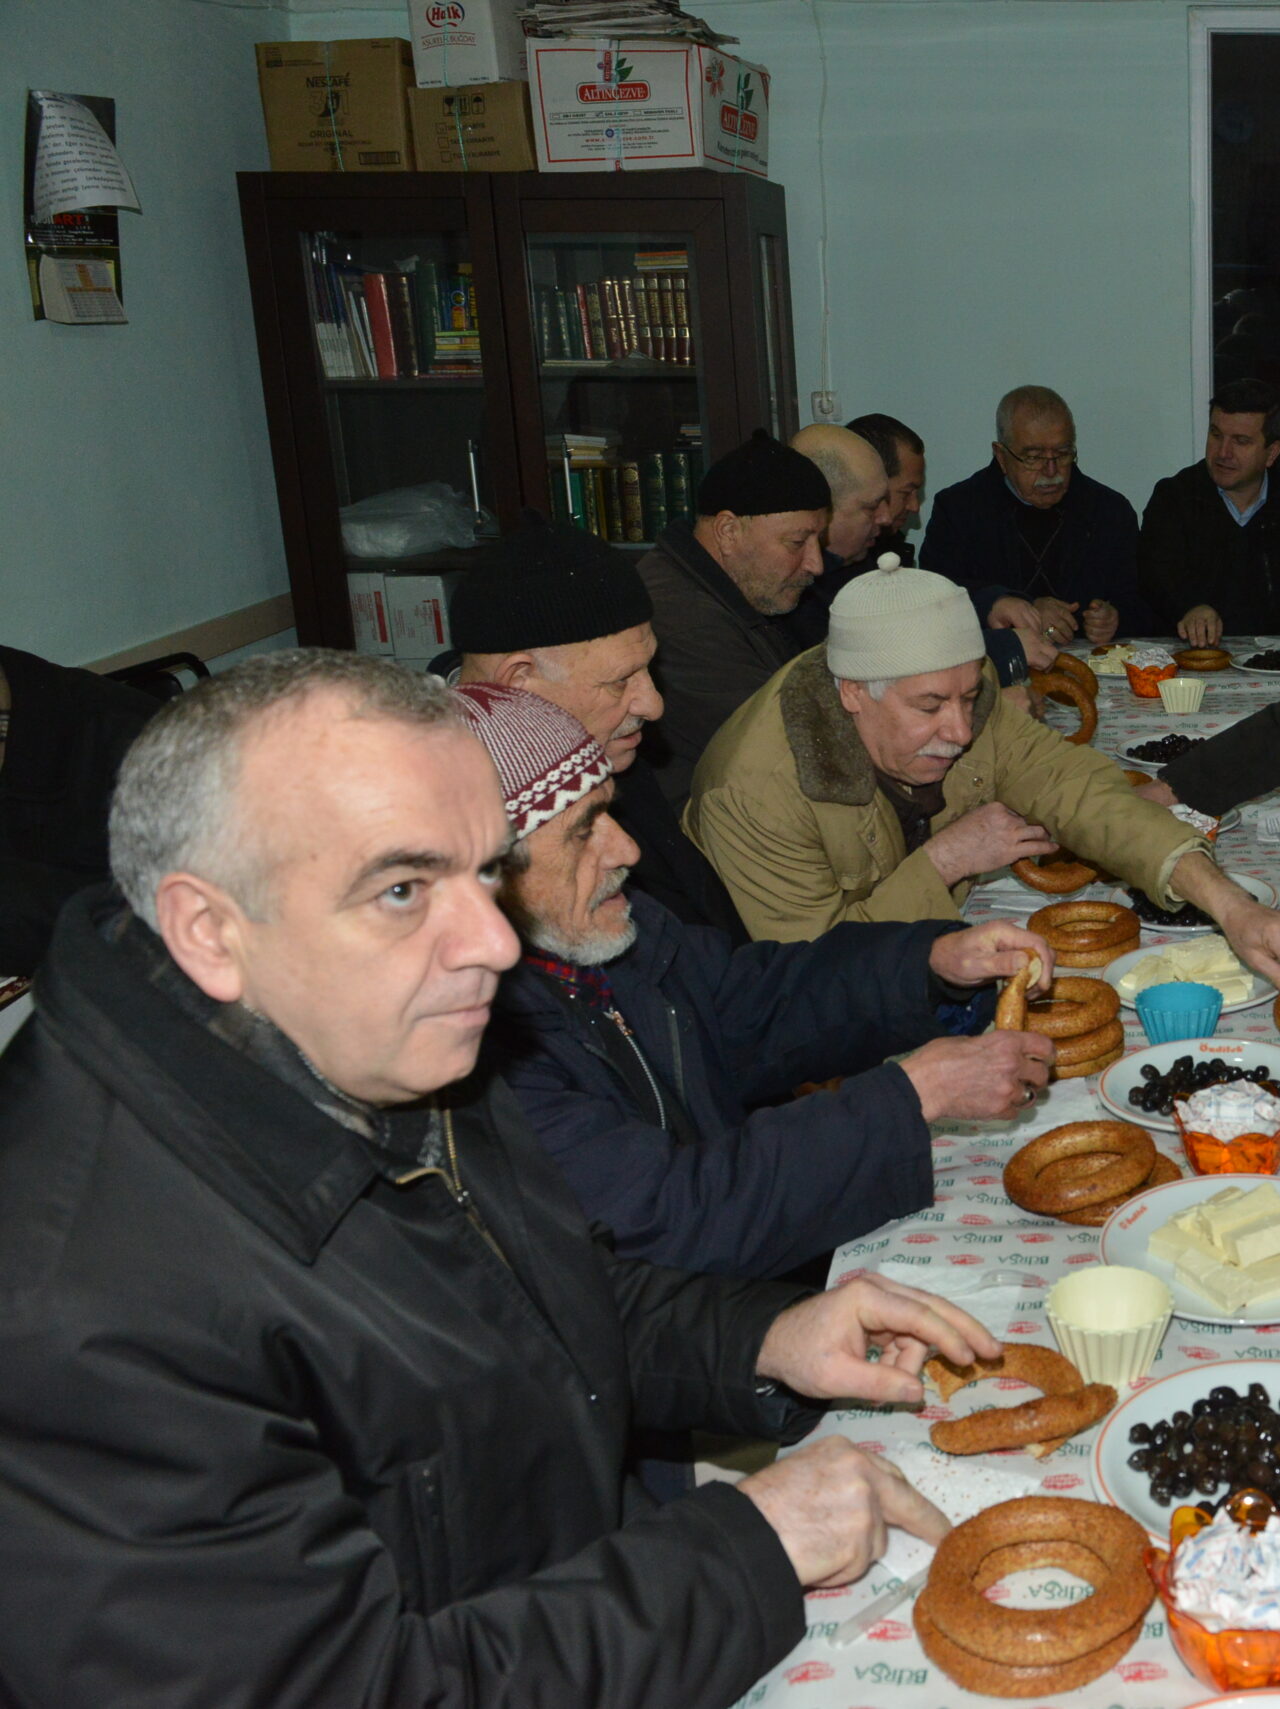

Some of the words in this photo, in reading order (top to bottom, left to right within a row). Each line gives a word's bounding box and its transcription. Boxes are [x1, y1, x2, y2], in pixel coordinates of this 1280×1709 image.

[432, 6, 461, 21] Halk
[953, 1232, 1004, 1244] BURSA
[999, 1252, 1050, 1265] BURSA
[855, 1662, 929, 1687] BURSA
